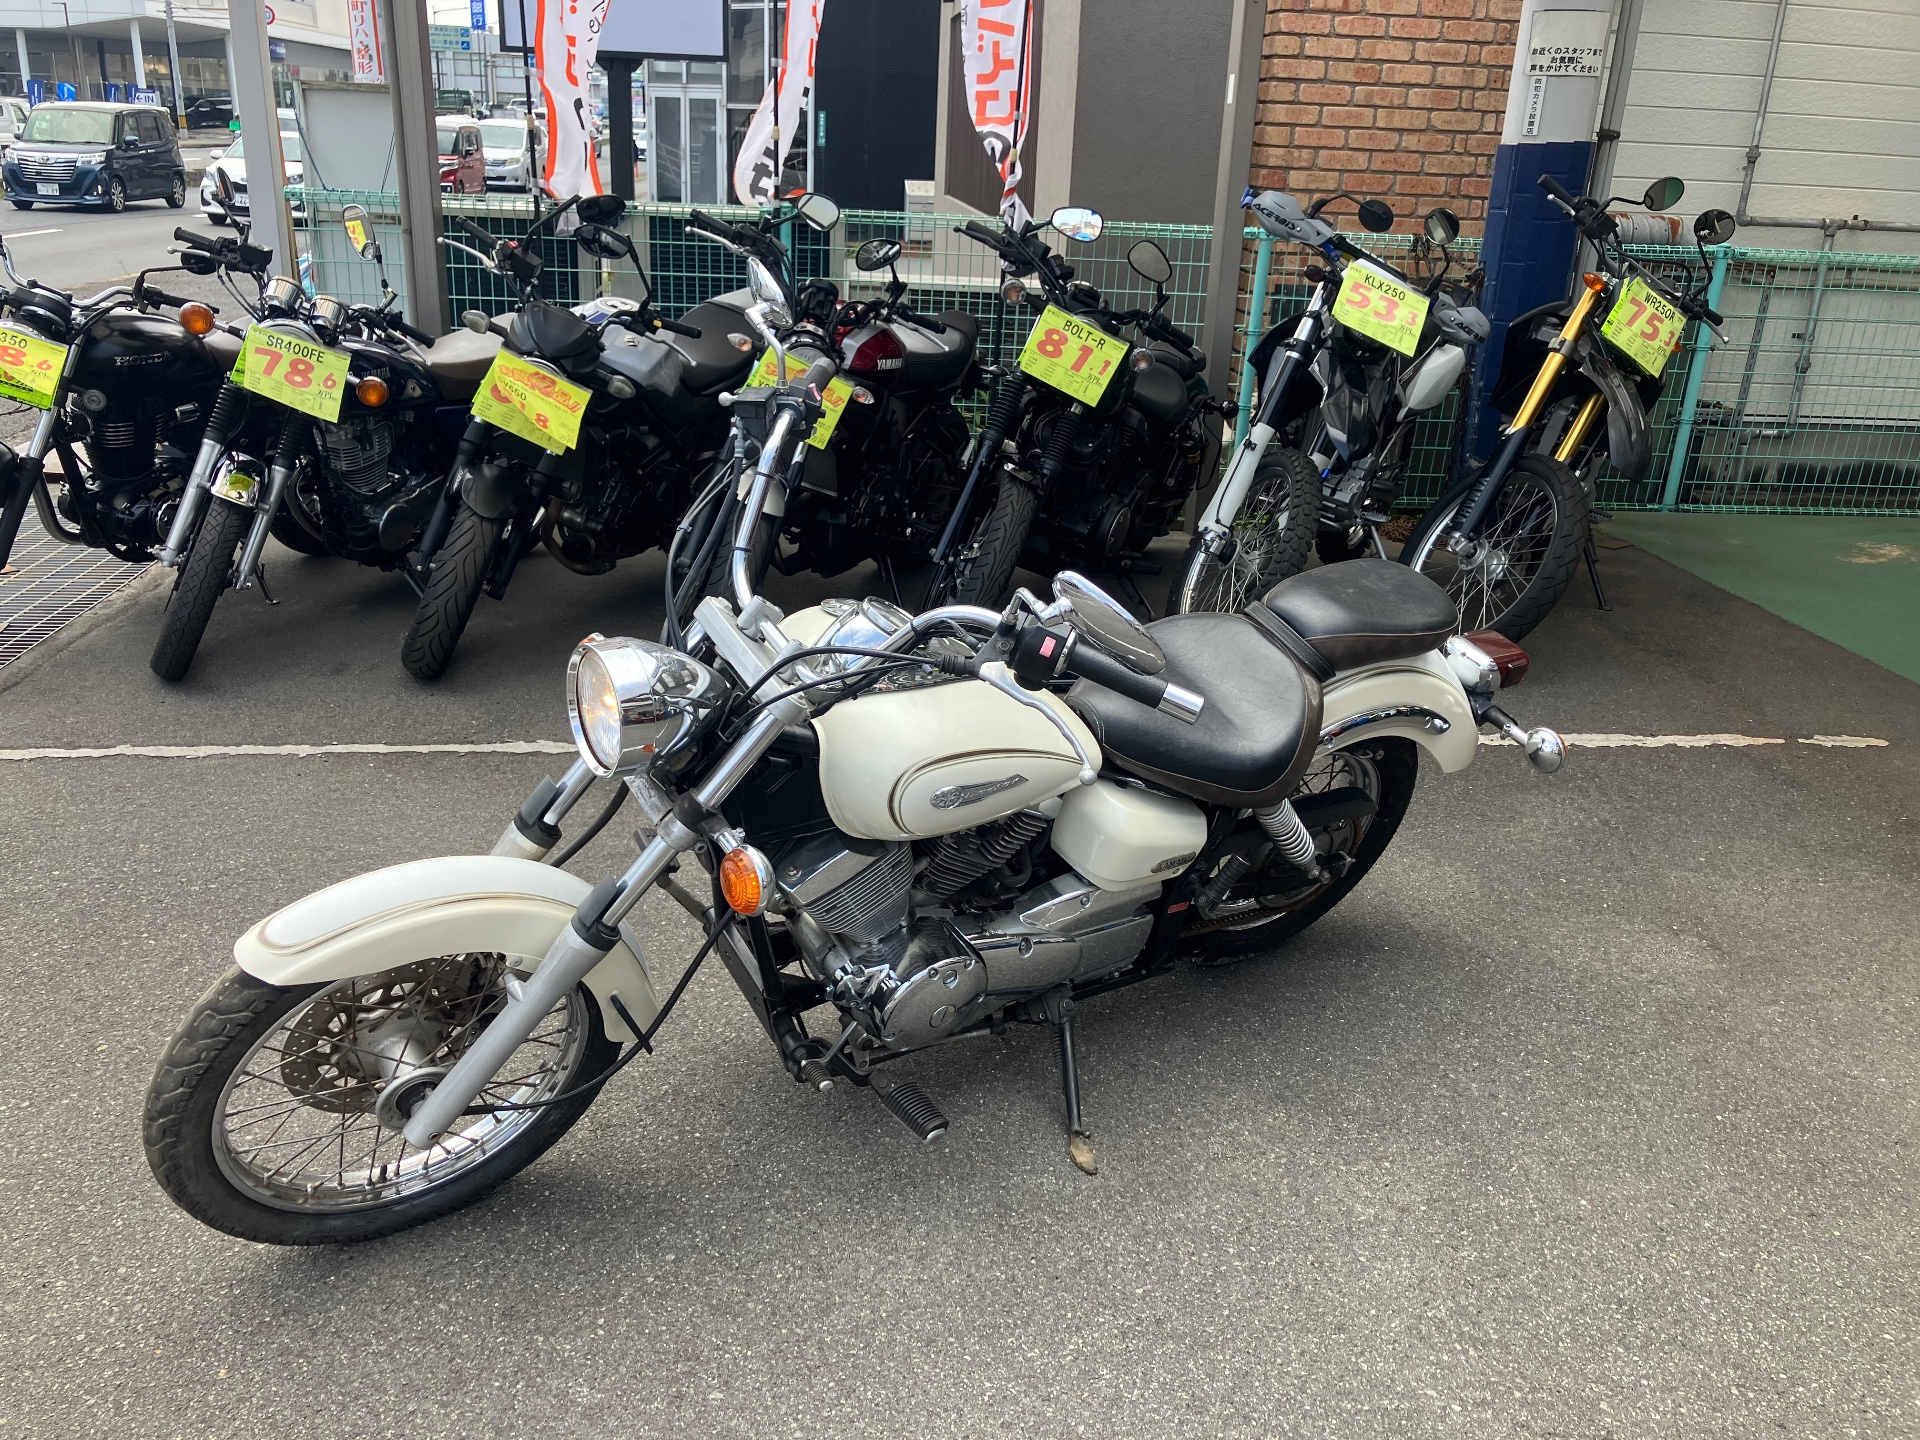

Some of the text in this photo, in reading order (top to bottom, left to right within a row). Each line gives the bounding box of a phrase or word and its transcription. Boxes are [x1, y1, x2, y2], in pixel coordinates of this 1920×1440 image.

[1531, 46, 1603, 56] お近くのスタッフまで
[1550, 56, 1583, 65] お気軽に
[1529, 64, 1599, 73] 声をかけてください
[144, 95, 154, 103] IN
[1526, 78, 1542, 135] 防犯カメラ設置店
[1253, 203, 1296, 230] ACERBIS
[1364, 273, 1406, 301] KLX250
[1644, 291, 1676, 323] WR250R
[1062, 319, 1106, 350] BOLT-R
[266, 334, 326, 363] SR400FE
[877, 358, 903, 371] YAMAHA
[1455, 477, 1490, 523] YAMAHA
